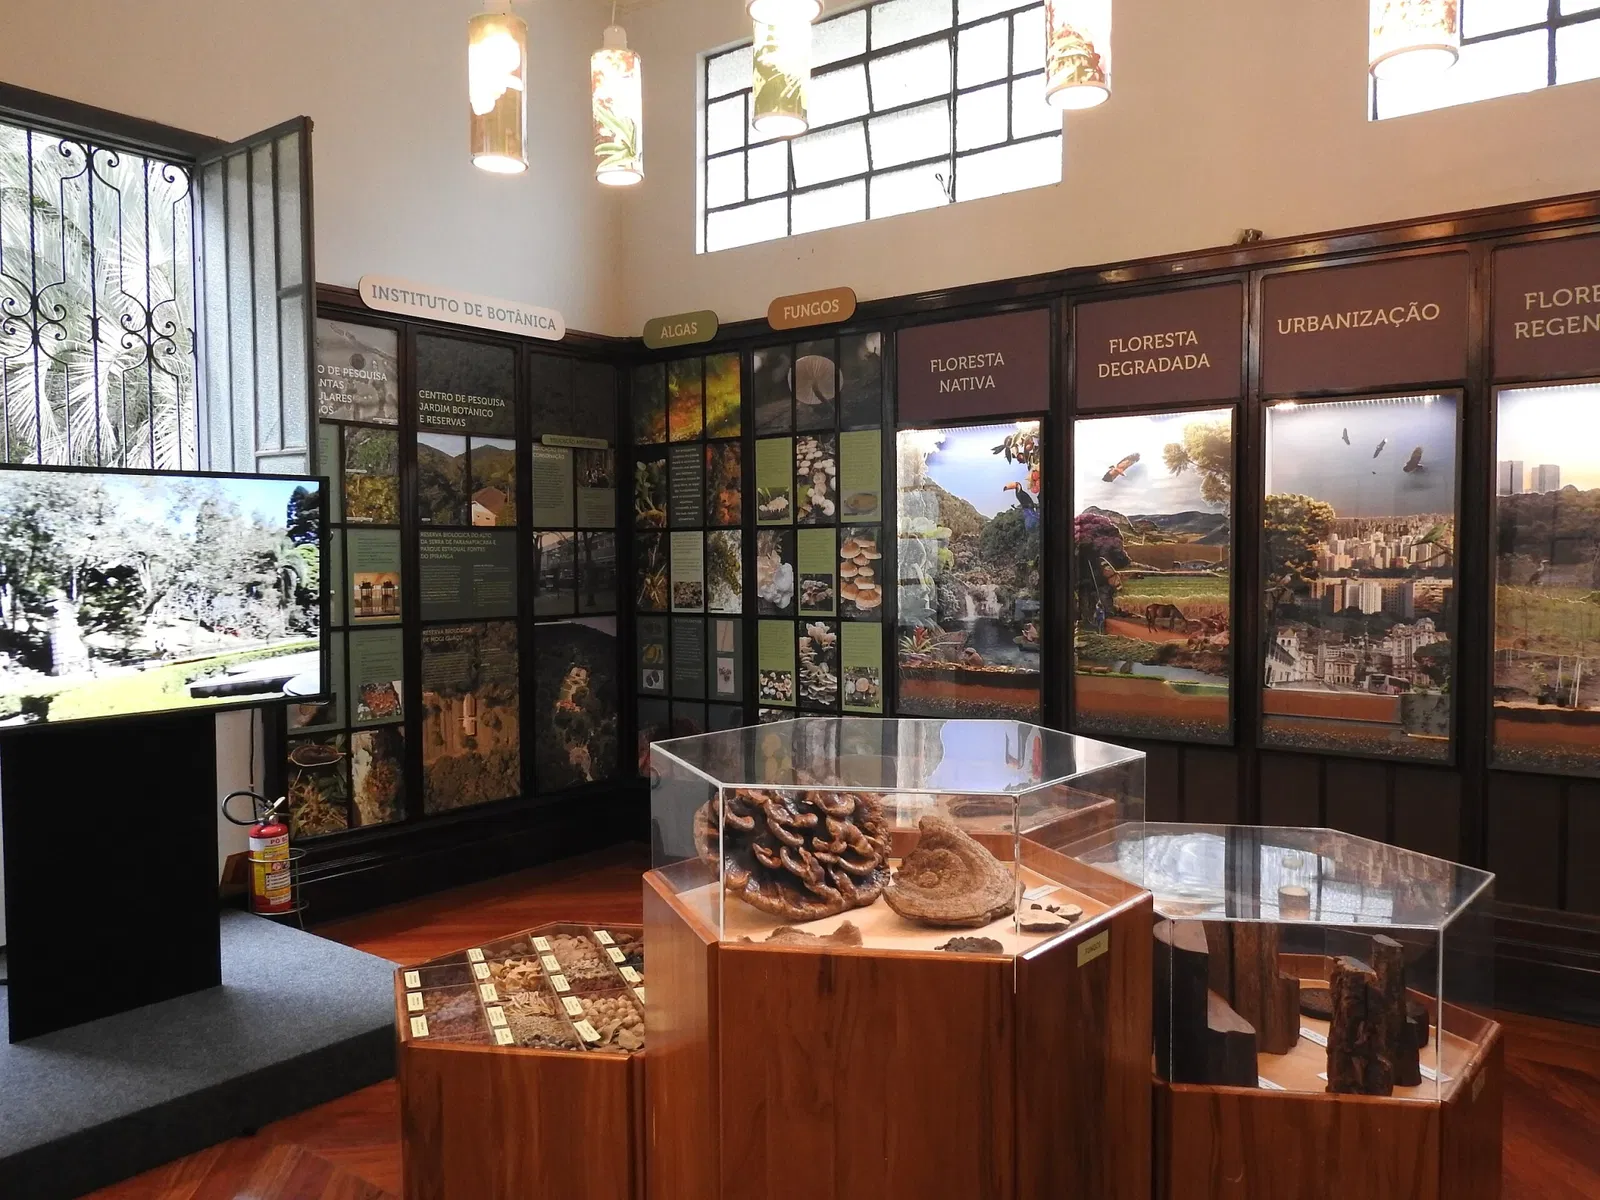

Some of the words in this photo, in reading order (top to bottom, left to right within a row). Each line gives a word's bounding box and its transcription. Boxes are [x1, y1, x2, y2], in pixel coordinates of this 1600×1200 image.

[371, 284, 459, 313] INSTITUTO
[464, 302, 483, 317] DE
[487, 306, 557, 331] BOTÂNICA
[784, 299, 839, 320] FUNGOS
[1278, 301, 1440, 335] URBANIZAÇÃO
[661, 322, 698, 339] ALGAS
[1514, 315, 1600, 340] REGEN
[1108, 330, 1198, 354] FLORESTA
[930, 352, 1005, 373] FLORESTA
[1098, 353, 1211, 378] DEGRADADA
[327, 366, 341, 376] DE
[343, 367, 388, 382] PESQUISA
[939, 375, 996, 393] NATIVA
[418, 389, 454, 402] CENTRO
[455, 394, 466, 403] DE
[467, 395, 505, 408] PESQUISA
[418, 402, 451, 414] JARDIM
[452, 404, 494, 418] BOTÂNICO
[419, 415, 425, 423] E
[426, 416, 466, 427] RESERVAS
